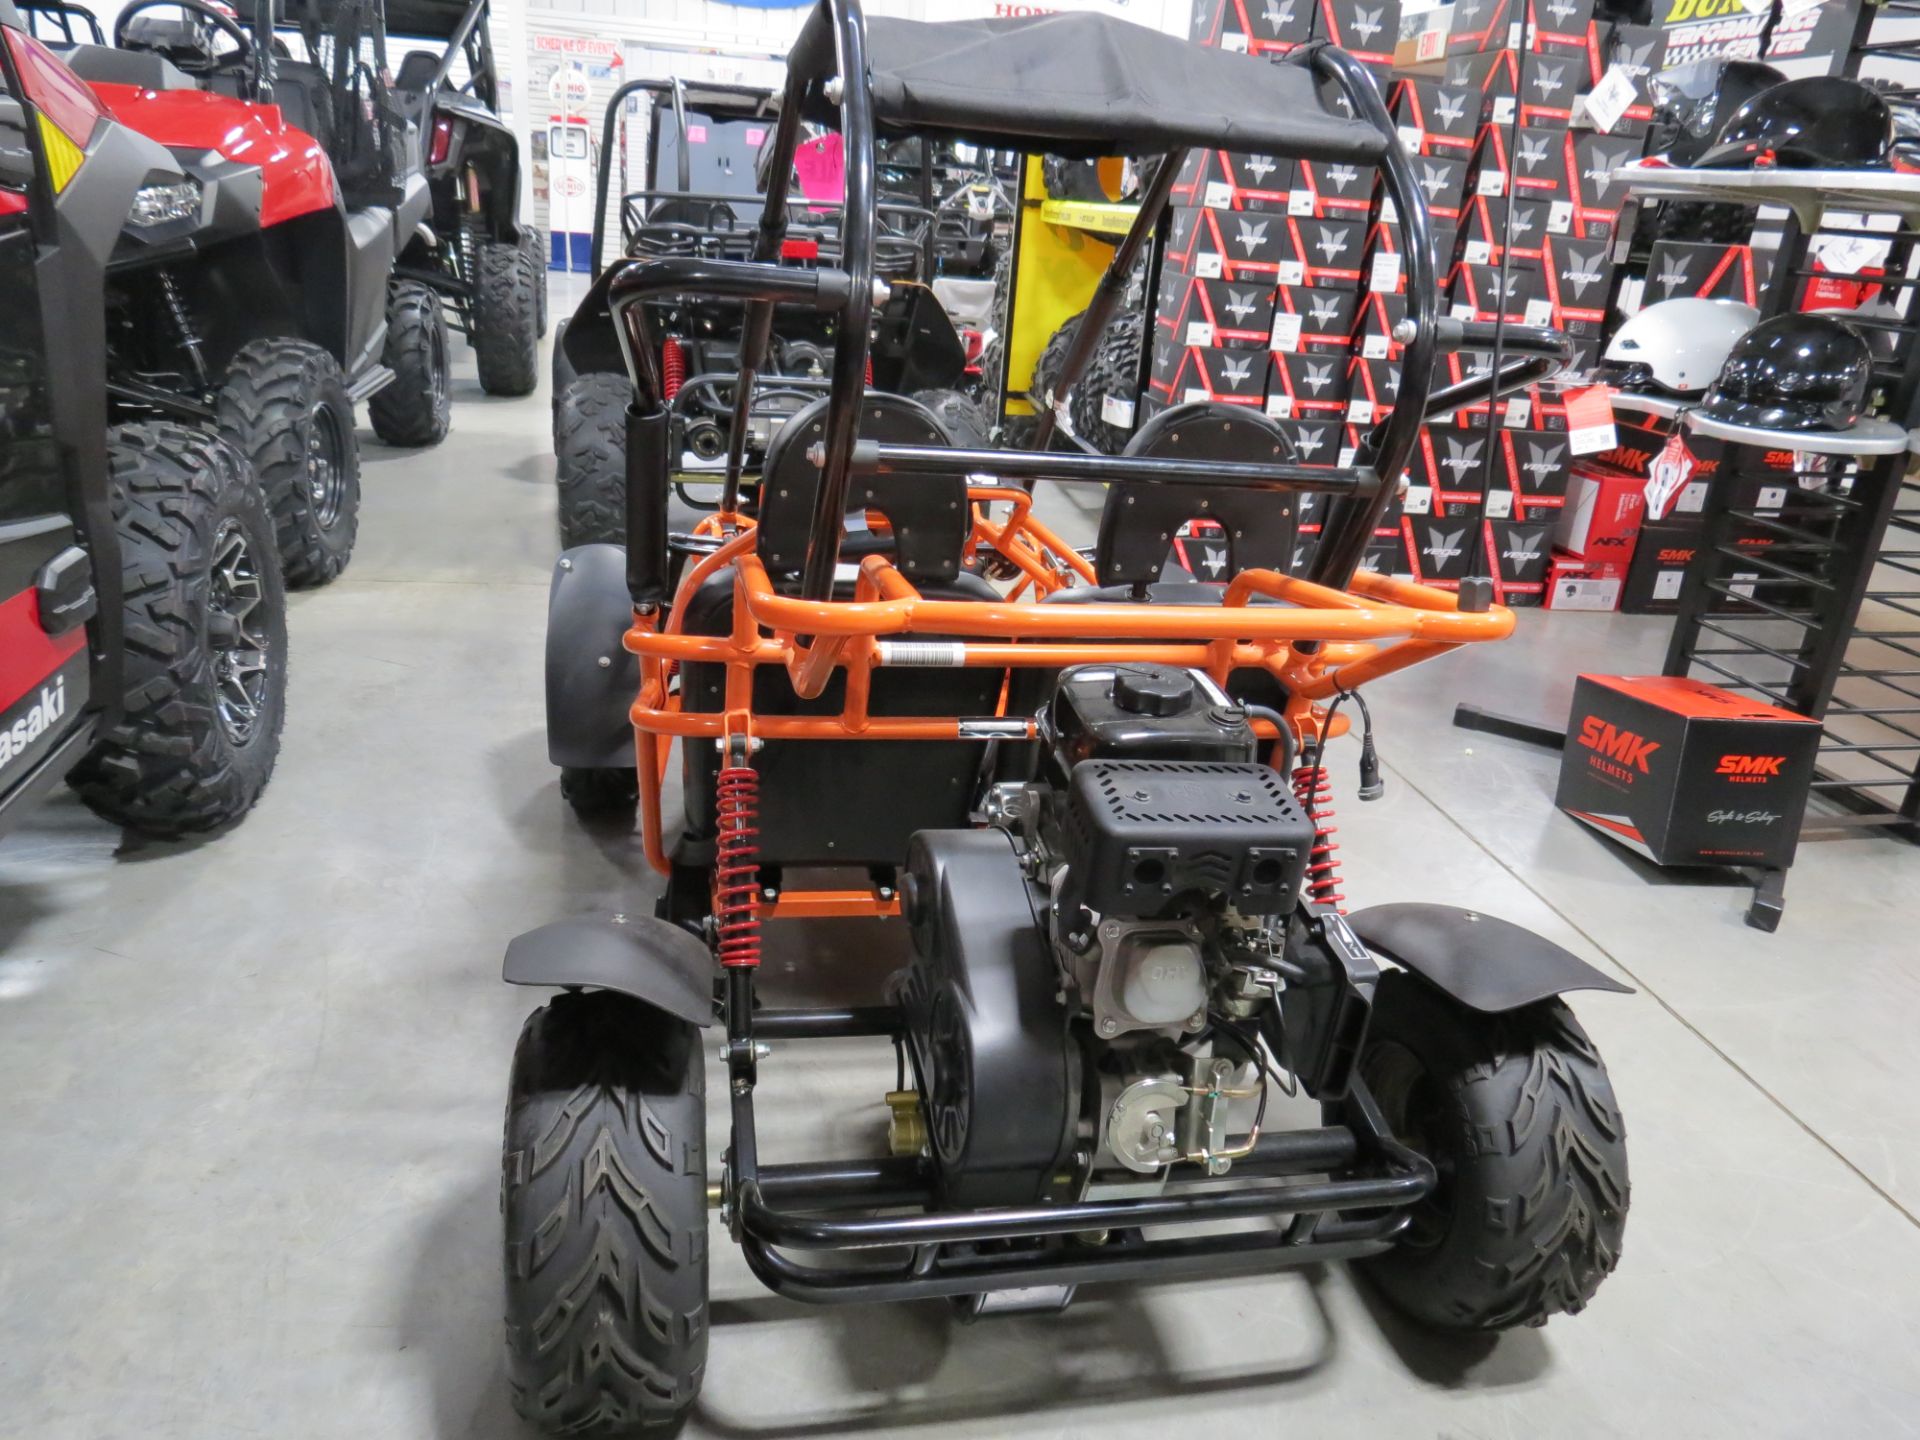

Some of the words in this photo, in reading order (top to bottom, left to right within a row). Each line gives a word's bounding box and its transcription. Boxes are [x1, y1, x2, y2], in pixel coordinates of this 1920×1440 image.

[1584, 169, 1611, 183] veg
[1561, 270, 1603, 283] vega
[1657, 273, 1688, 285] vega
[1441, 458, 1482, 470] vega
[1522, 463, 1563, 474] vega
[1696, 460, 1720, 472] MK
[1423, 548, 1462, 558] vega
[1502, 550, 1541, 561] vega
[1657, 550, 1697, 561] SMK
[1577, 715, 1663, 774] SMK
[1589, 755, 1635, 785] HELMETS
[1715, 755, 1787, 775] SMK
[1729, 775, 1768, 784] HELMETS
